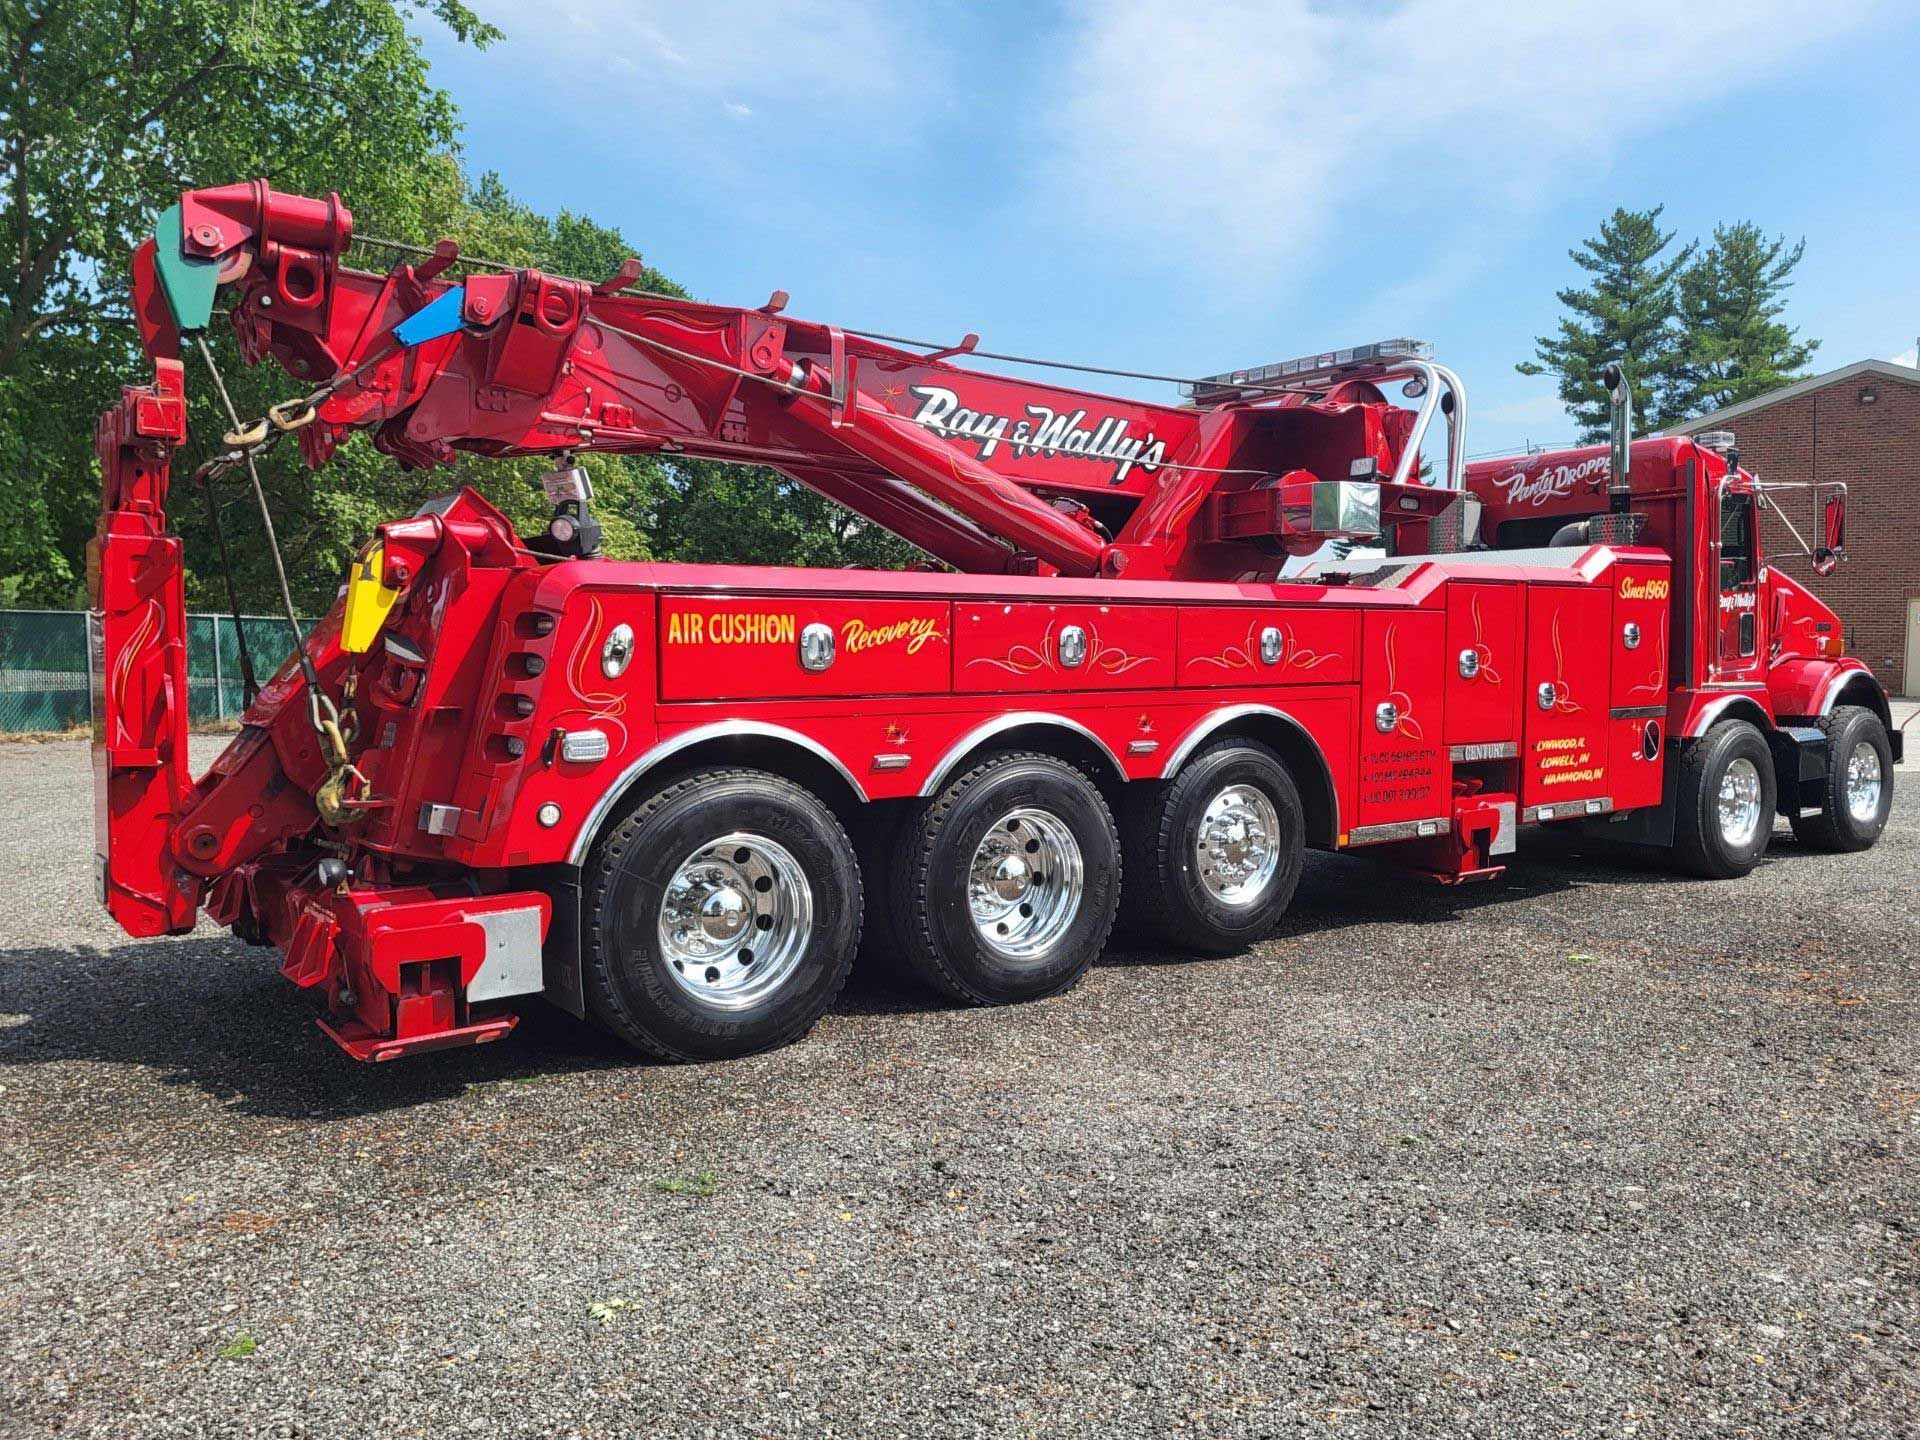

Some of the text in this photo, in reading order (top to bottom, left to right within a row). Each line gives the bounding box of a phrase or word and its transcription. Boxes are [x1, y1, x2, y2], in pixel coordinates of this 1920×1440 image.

[909, 384, 1167, 484] Ray & Wally's
[1492, 456, 1611, 506] Panty DROPPE
[1618, 576, 1668, 600] Since 1960
[668, 612, 795, 644] AIR CUSHION
[842, 617, 943, 655] Recovery
[1464, 743, 1505, 761] CENTURY
